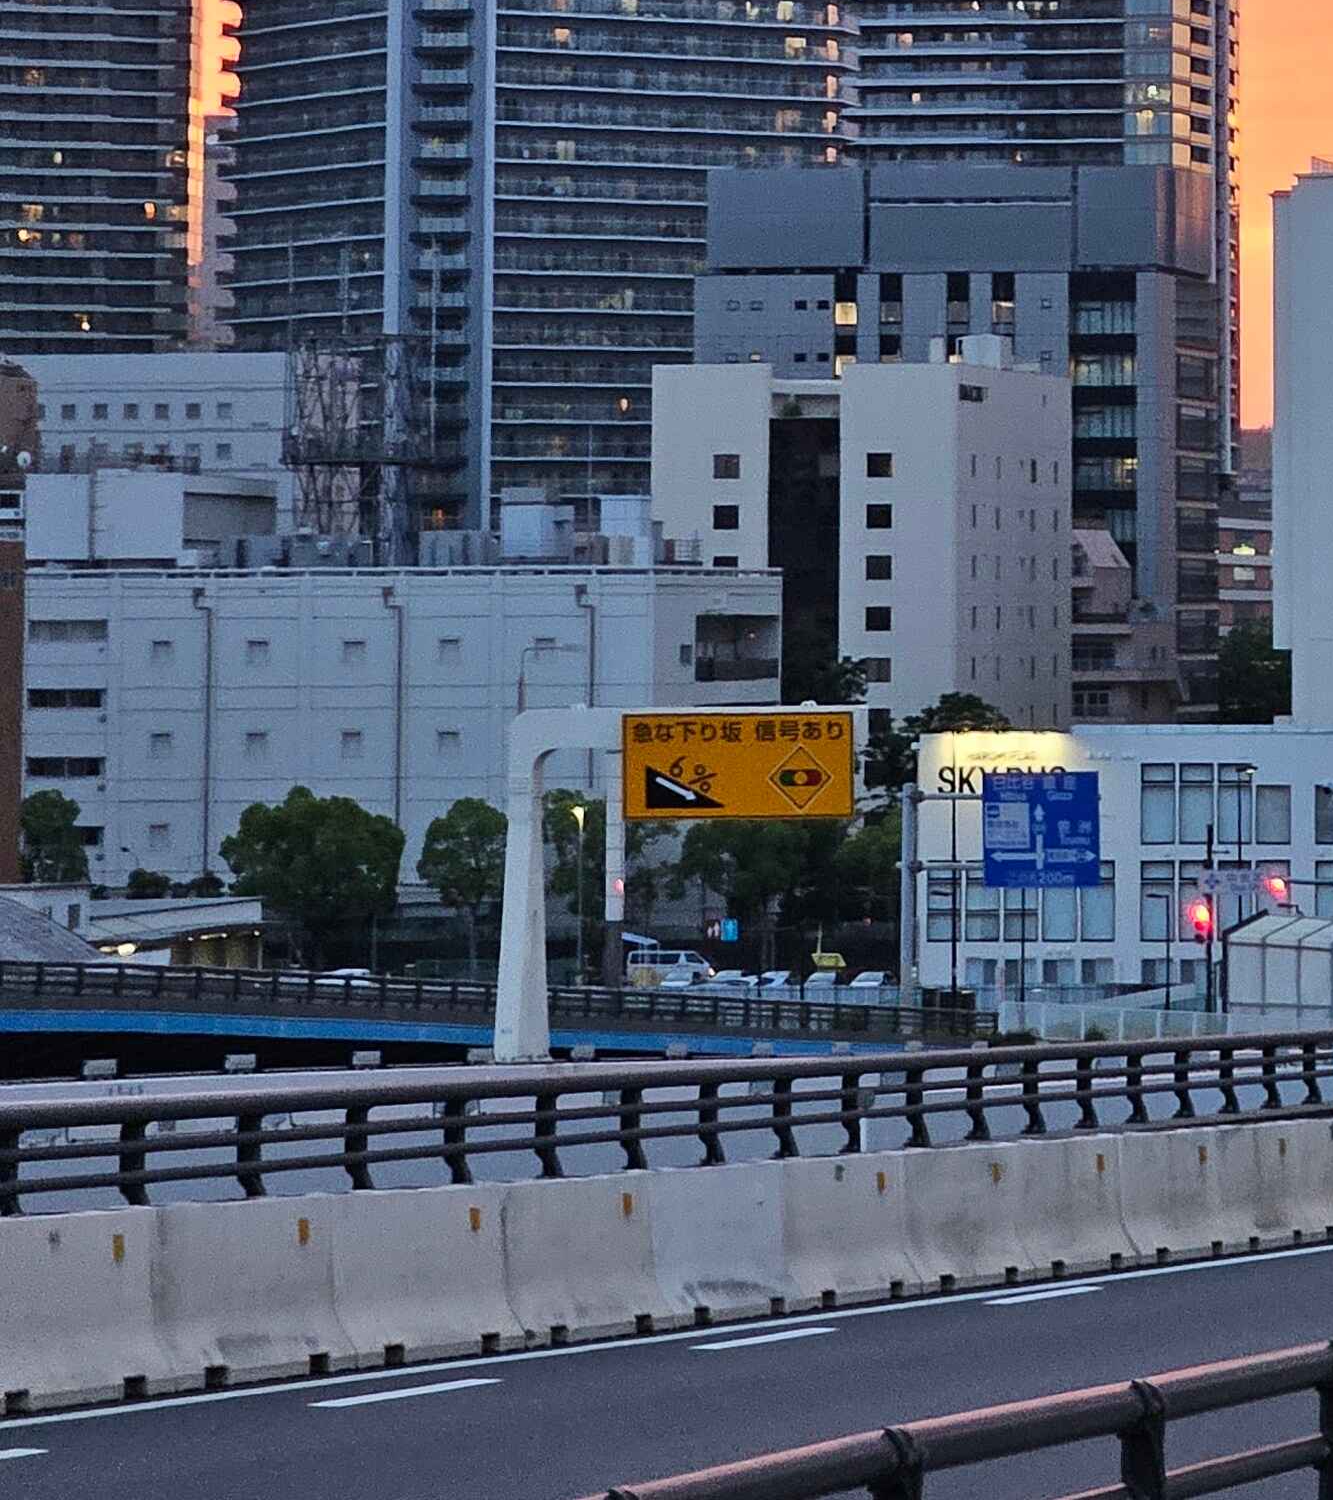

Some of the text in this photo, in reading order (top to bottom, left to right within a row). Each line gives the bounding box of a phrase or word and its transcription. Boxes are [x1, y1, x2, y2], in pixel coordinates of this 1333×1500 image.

[633, 720, 843, 743] 急な下り坂 信号あり
[669, 755, 718, 793] 6%
